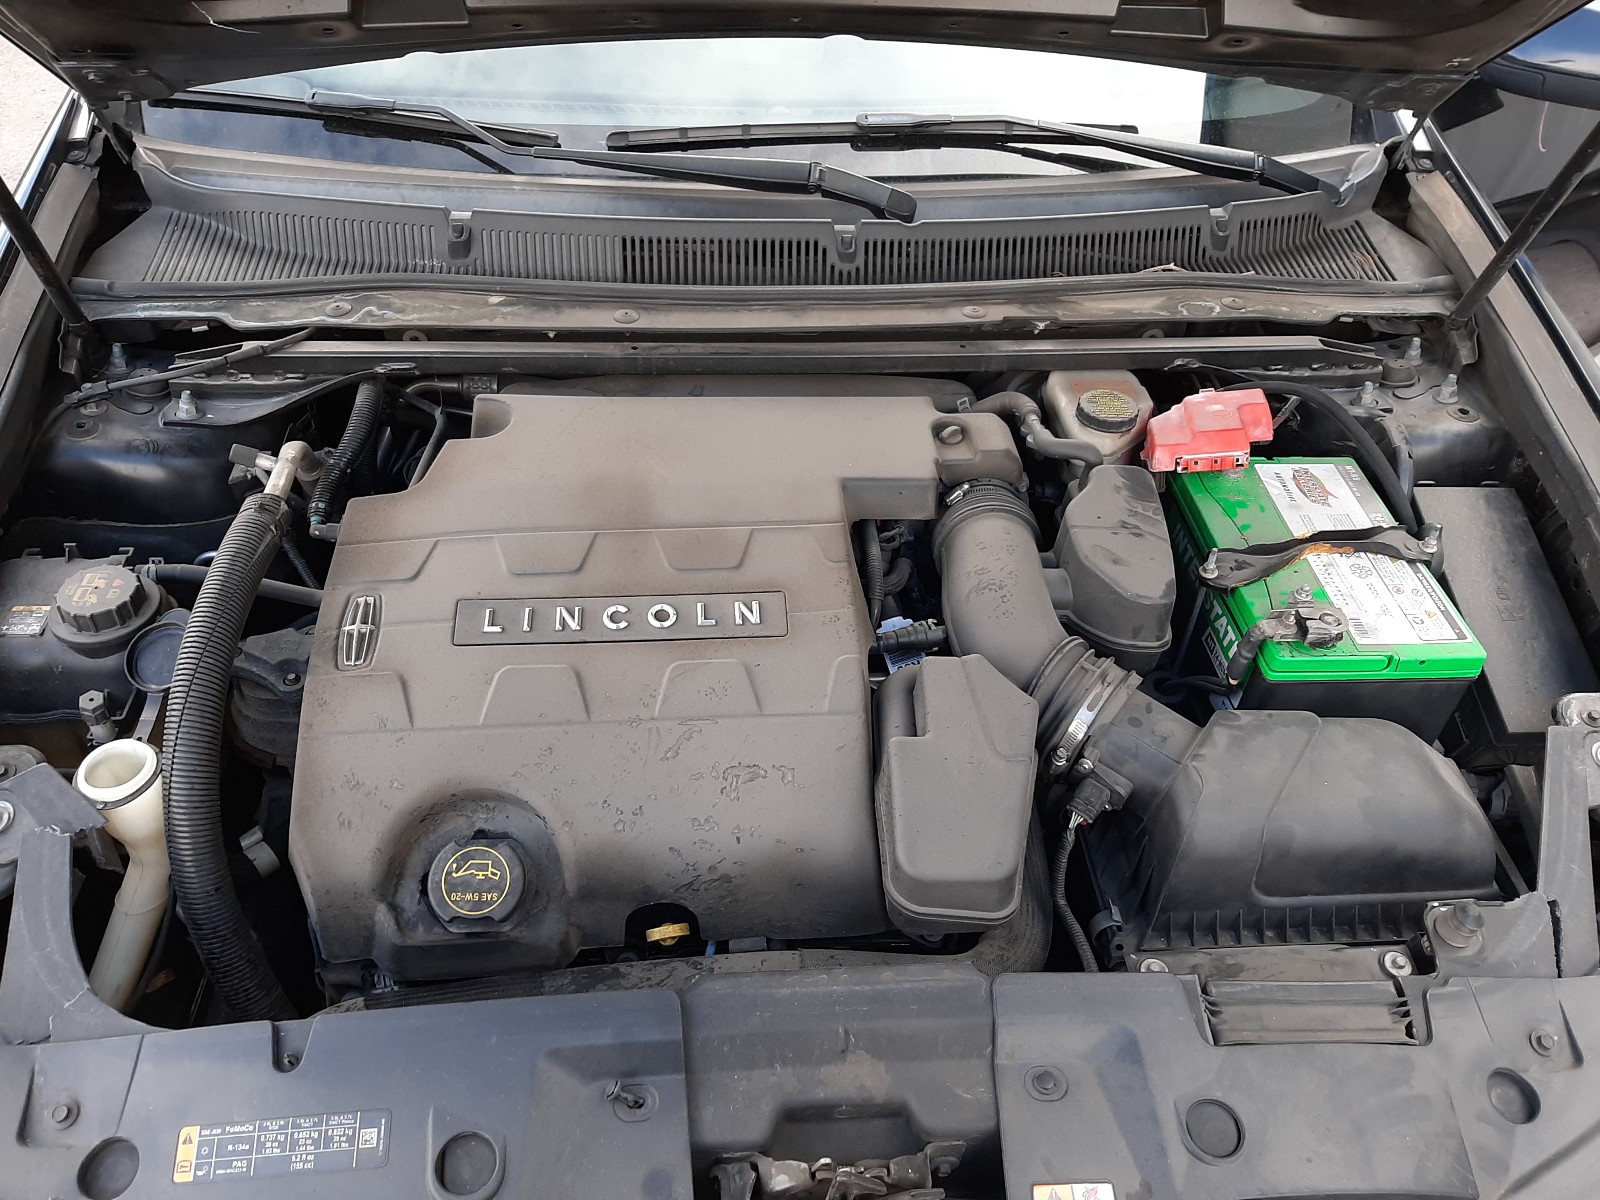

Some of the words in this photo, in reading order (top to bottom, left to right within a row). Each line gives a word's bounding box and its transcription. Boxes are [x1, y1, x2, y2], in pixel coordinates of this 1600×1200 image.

[482, 600, 761, 633] LINCOLN
[451, 893, 479, 901] 5W-20
[481, 893, 498, 901] SAE
[225, 1124, 254, 1134] FoMoCo
[345, 1128, 353, 1136] kg
[277, 1133, 285, 1142] kg
[311, 1131, 318, 1139] kg
[227, 1143, 250, 1152] R-134a
[232, 1160, 247, 1168] PAG
